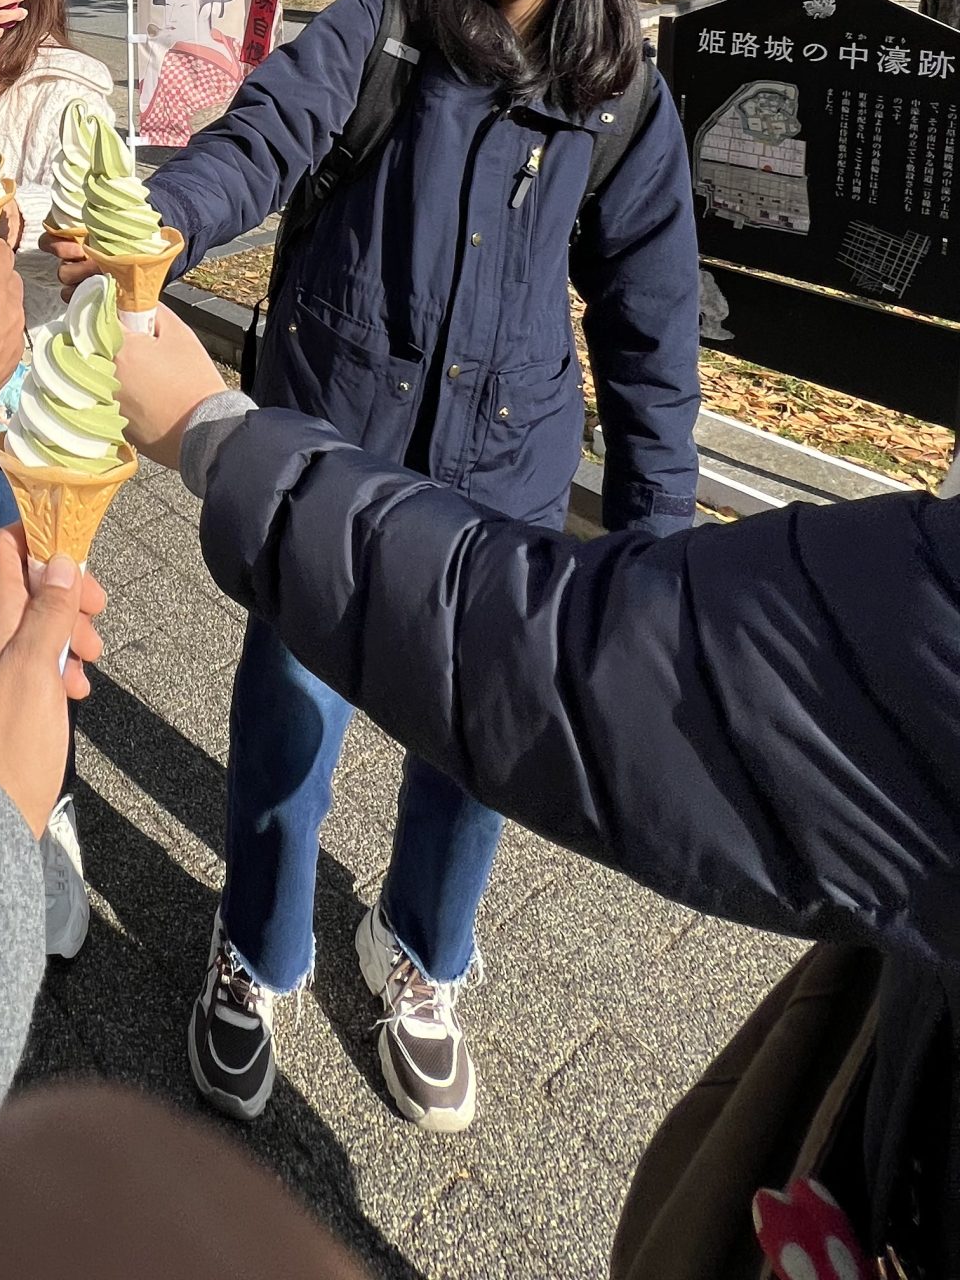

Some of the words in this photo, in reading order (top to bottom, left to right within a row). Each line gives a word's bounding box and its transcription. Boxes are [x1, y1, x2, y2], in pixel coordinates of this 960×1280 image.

[697, 28, 956, 80] 姫路城の中濠跡
